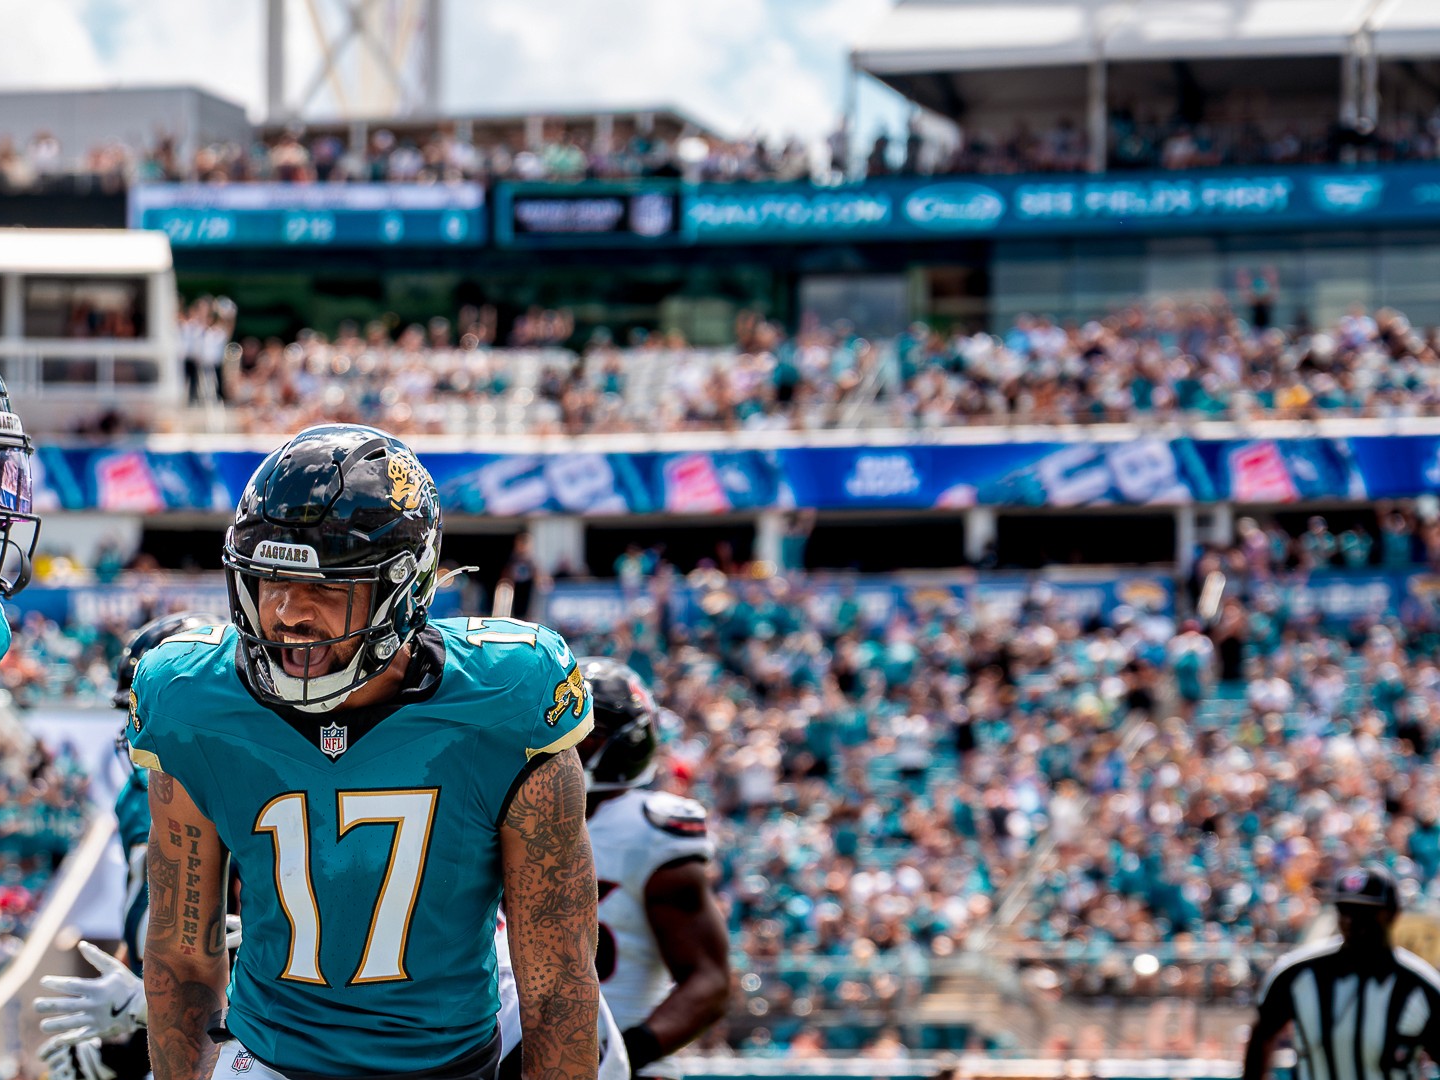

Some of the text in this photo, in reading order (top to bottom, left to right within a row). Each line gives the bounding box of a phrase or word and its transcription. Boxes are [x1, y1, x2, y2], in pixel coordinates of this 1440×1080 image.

[260, 544, 309, 563] JAGUARS
[324, 737, 344, 751] NFL
[167, 817, 182, 848] BE
[180, 823, 202, 956] DIFFERENT
[252, 785, 443, 988] 17
[234, 1057, 250, 1070] NFL
